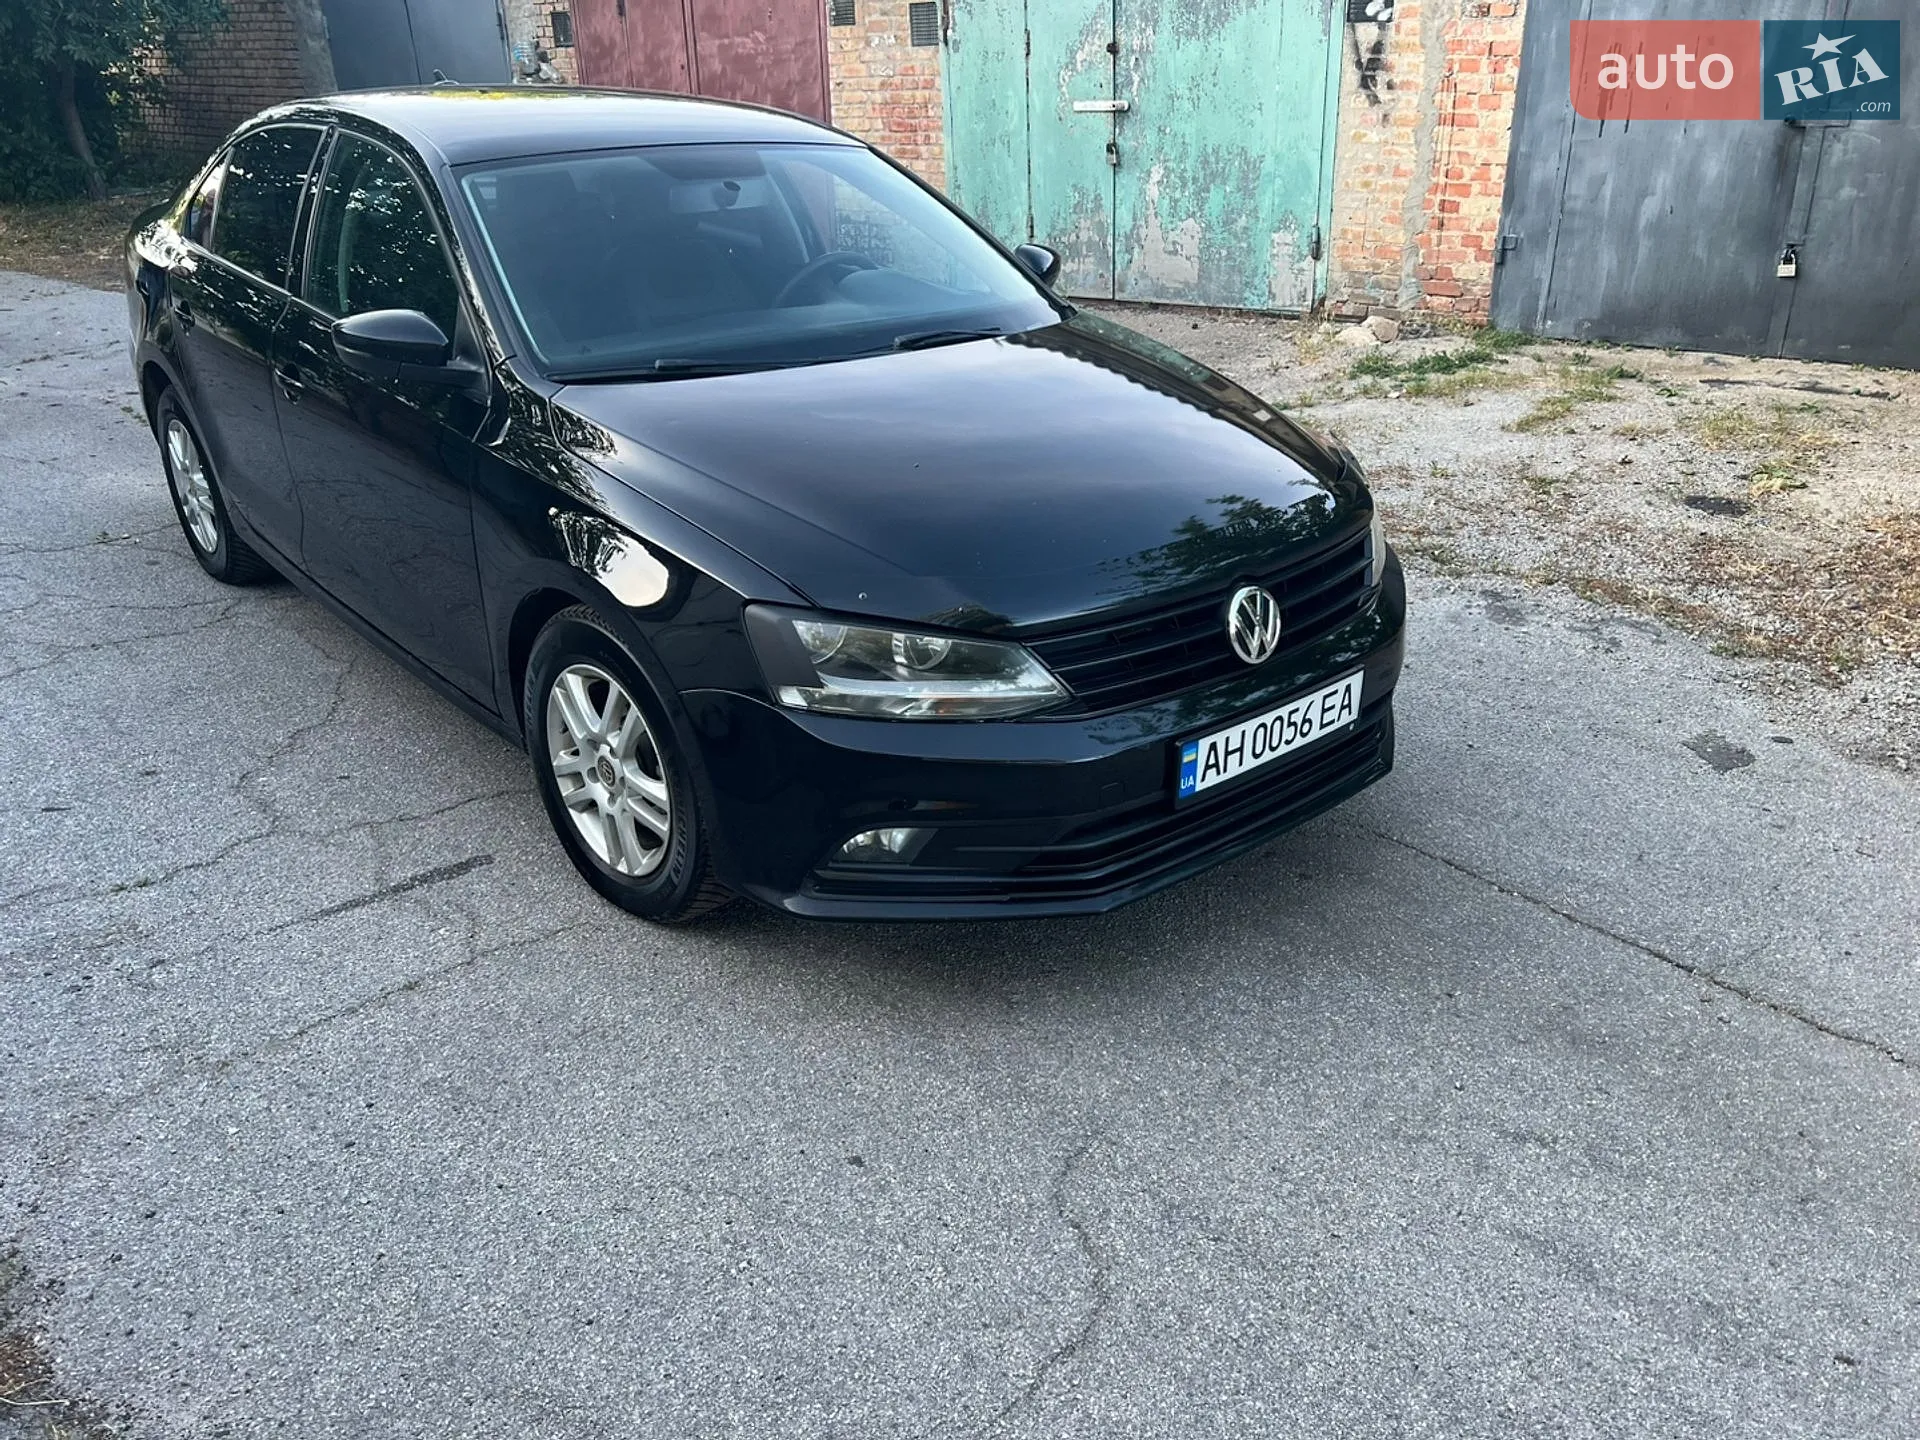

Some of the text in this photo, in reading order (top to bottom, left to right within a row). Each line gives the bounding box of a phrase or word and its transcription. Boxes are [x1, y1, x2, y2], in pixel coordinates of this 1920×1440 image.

[1200, 683, 1352, 783] AH 0056 EA
[1181, 775, 1195, 789] UA
